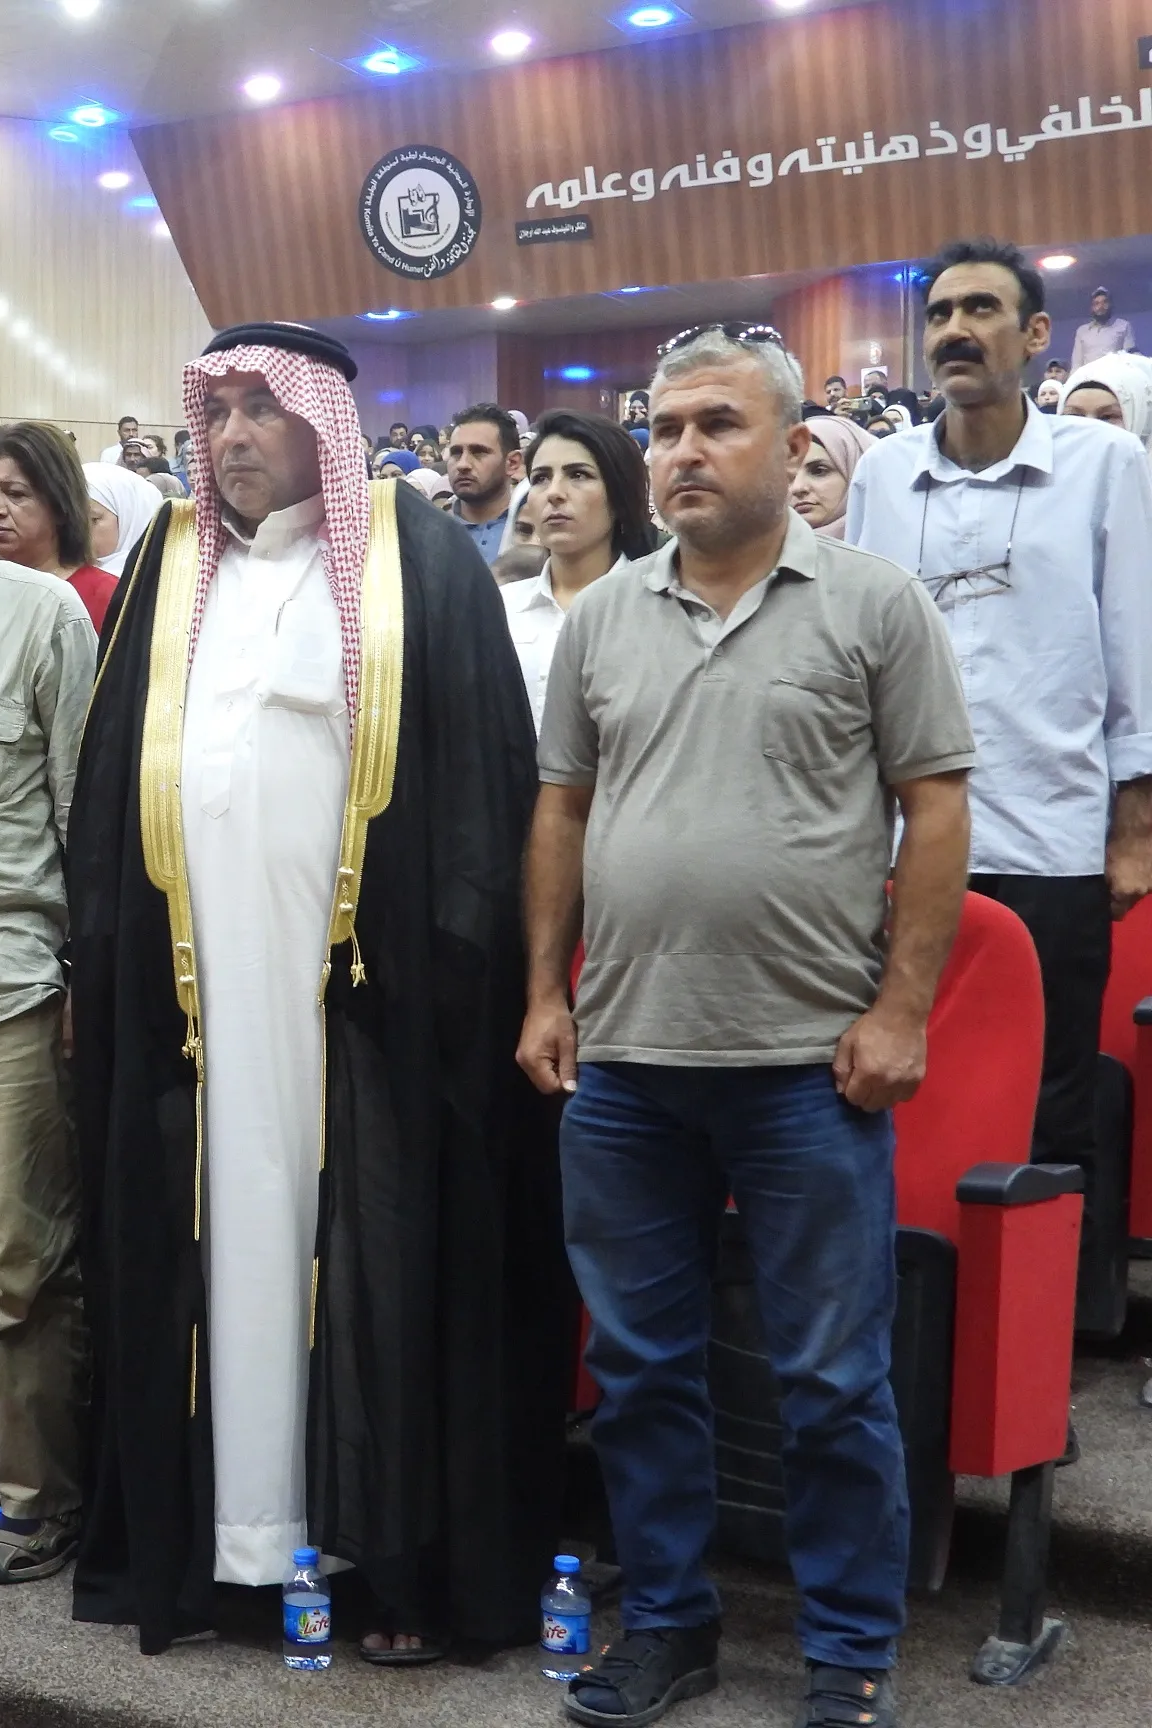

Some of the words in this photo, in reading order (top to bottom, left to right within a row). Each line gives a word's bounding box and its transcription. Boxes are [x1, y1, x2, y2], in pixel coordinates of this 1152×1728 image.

[659, 150, 774, 191] وفنه
[777, 121, 992, 176] وذهنيته
[525, 165, 655, 209] وعلمه
